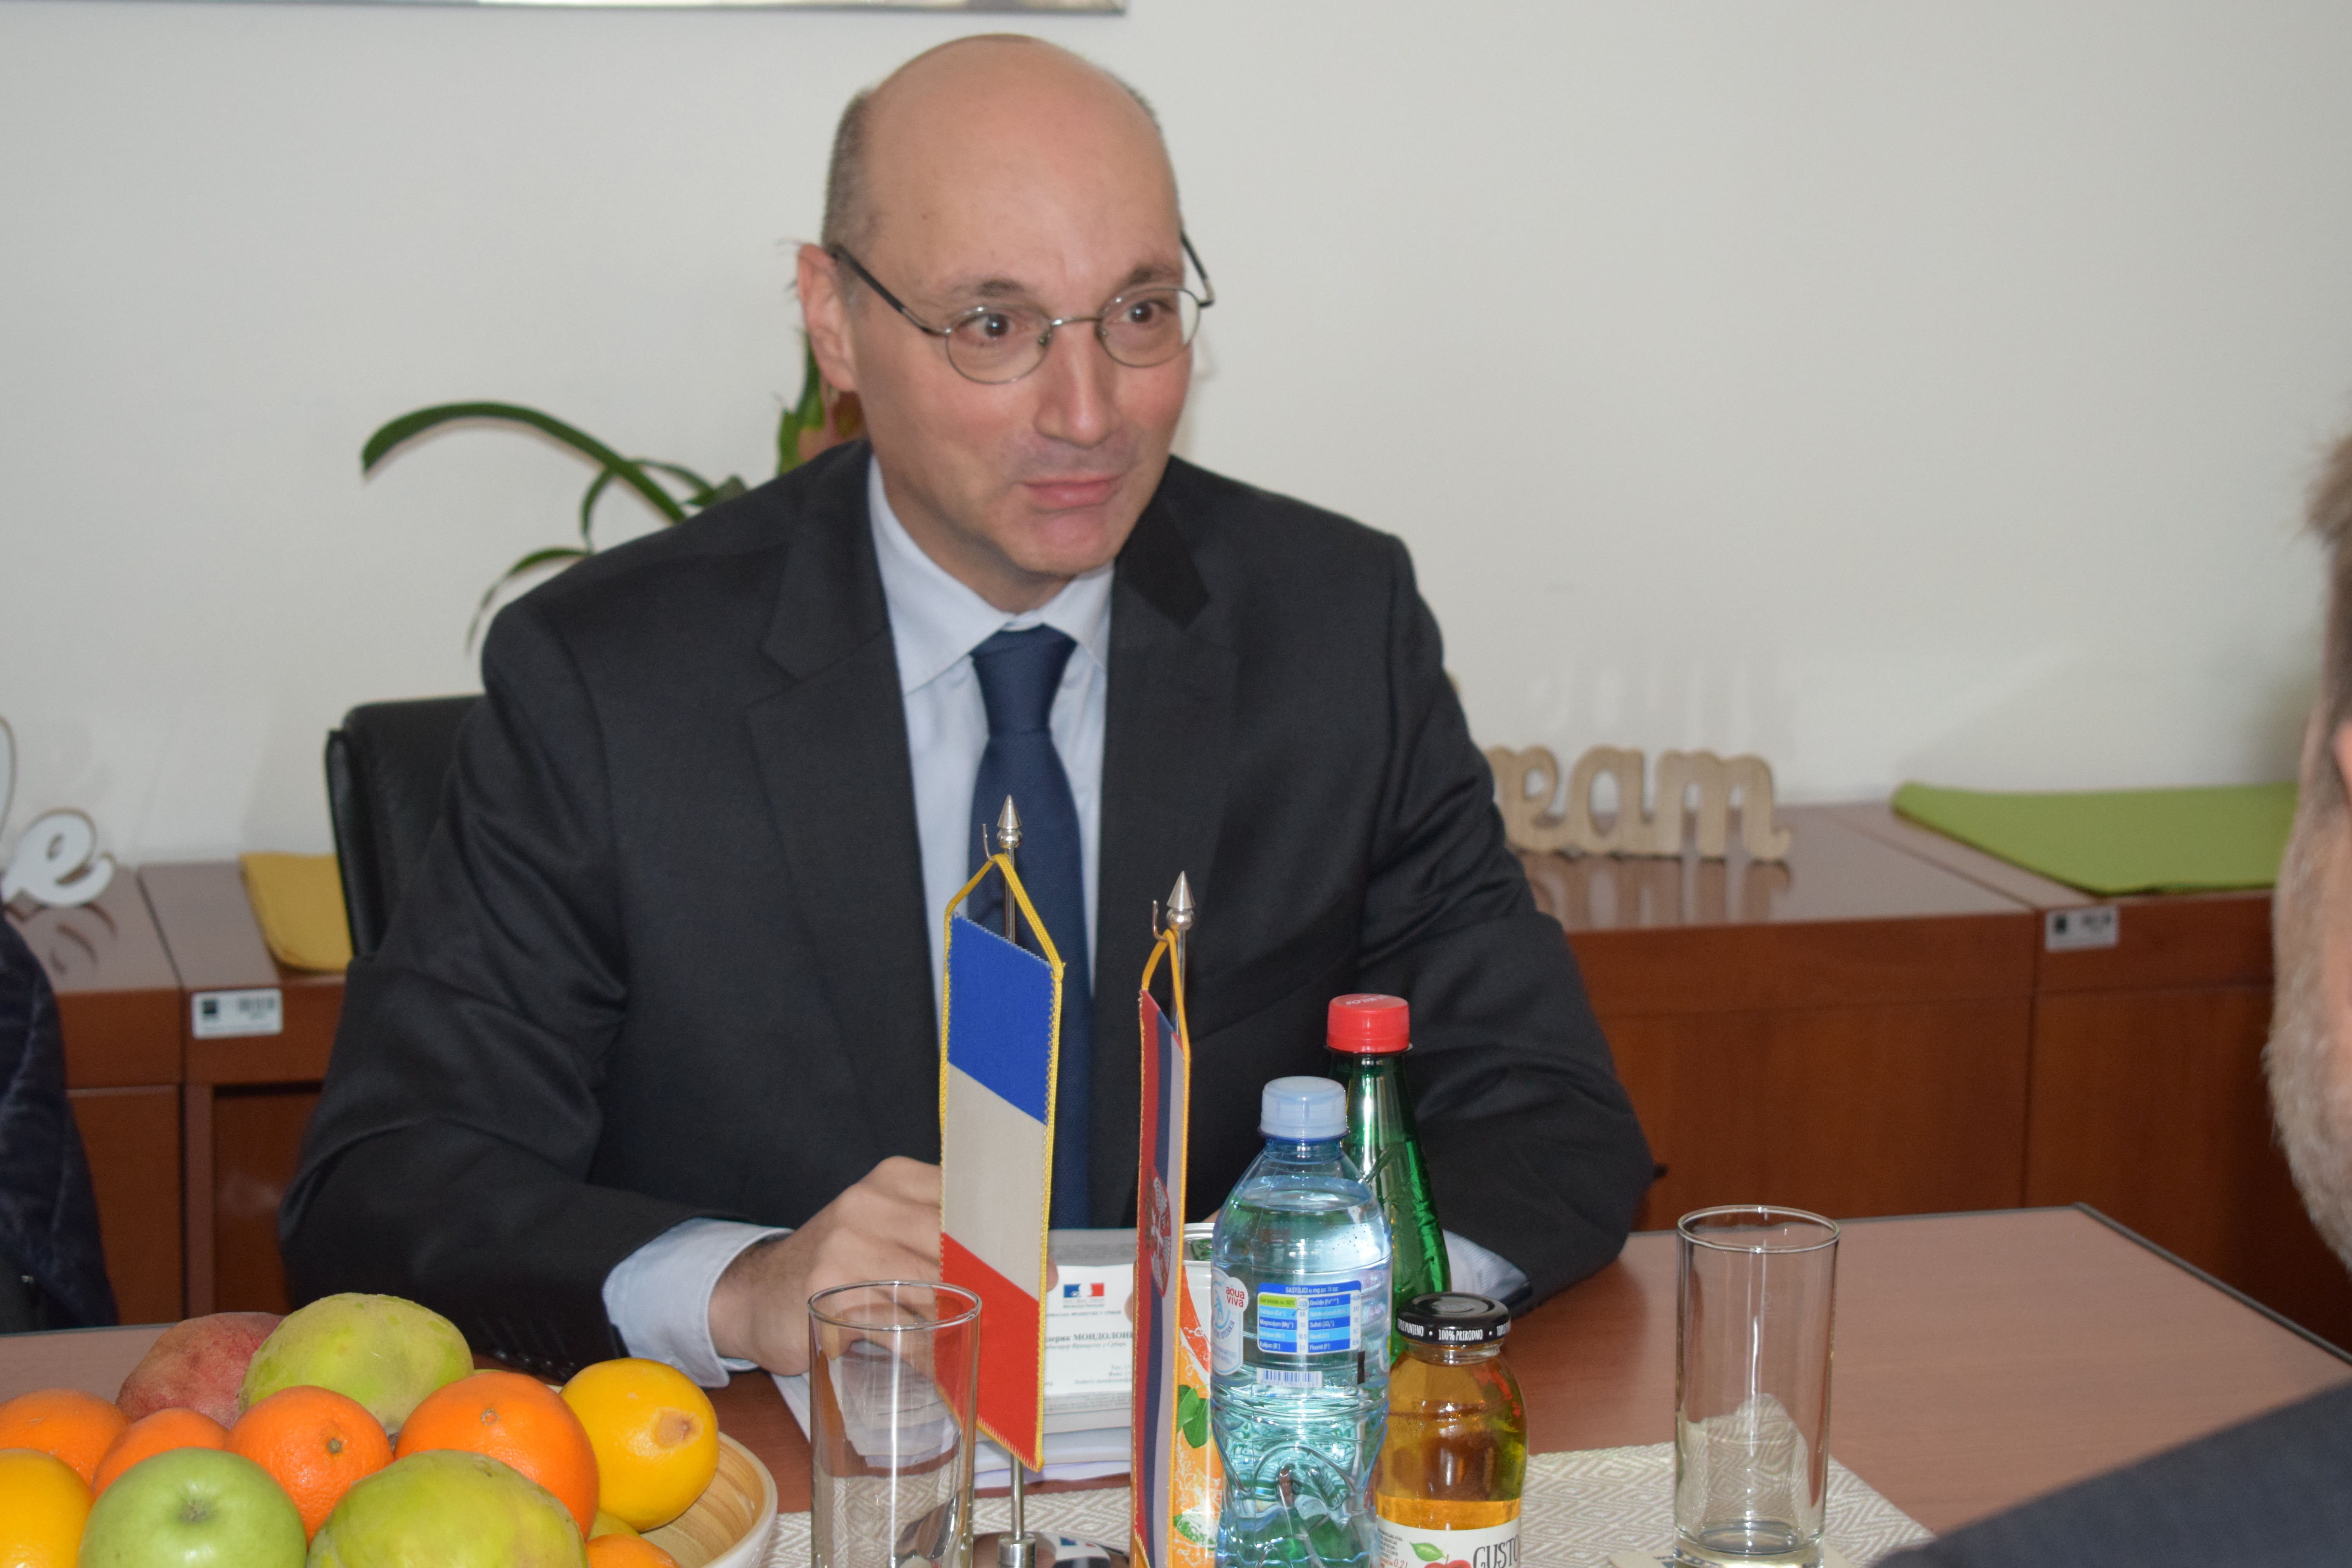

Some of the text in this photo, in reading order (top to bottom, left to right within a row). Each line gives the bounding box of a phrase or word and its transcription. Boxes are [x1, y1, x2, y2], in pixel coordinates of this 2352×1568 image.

[1484, 745, 1792, 858] eam
[1226, 1287, 1245, 1299] aqua
[1227, 1295, 1243, 1307] viva
[1405, 1321, 1424, 1337] PUNJENO
[1438, 1329, 1483, 1341] 100% PRIRODNO
[1473, 1534, 1519, 1568] GUSTO
